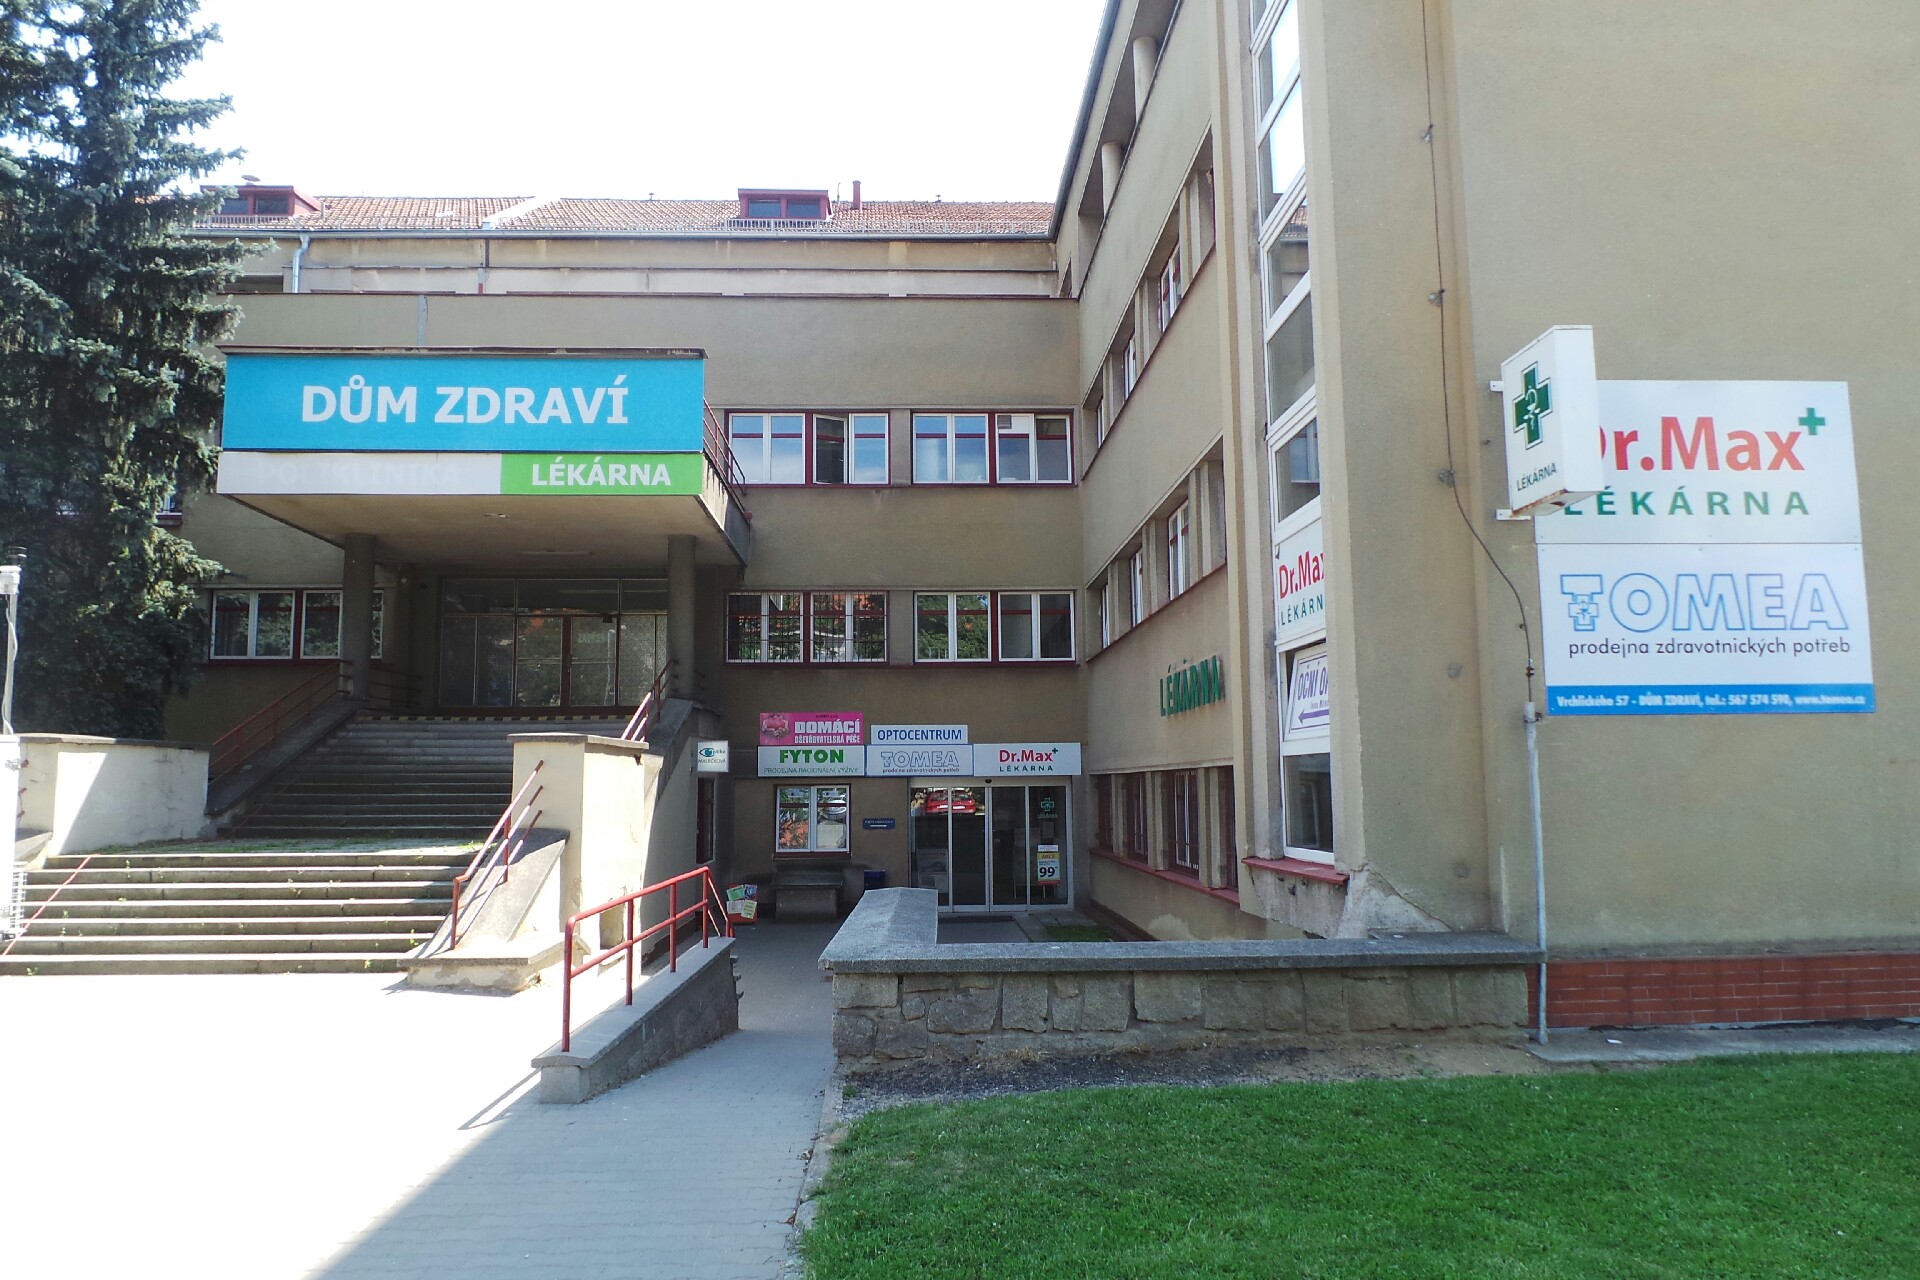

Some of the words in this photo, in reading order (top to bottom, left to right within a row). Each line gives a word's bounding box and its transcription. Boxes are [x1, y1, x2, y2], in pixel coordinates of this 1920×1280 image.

[302, 374, 418, 424] DŮM
[434, 374, 629, 425] ZDRAVÍ
[1599, 415, 1806, 472] r.Max
[531, 456, 672, 487] LÉKÁRNA
[1516, 462, 1558, 492] LÉKÁRNA
[1559, 572, 1849, 633] TOMEA
[1569, 637, 1650, 658] prodejna
[1656, 636, 1786, 658] zdravotnických
[1793, 636, 1851, 656] potřeb
[1159, 654, 1222, 717] LÉKÁRNA
[1297, 661, 1319, 701] OČNÍ
[794, 718, 860, 734] DOMÁCÍ
[877, 729, 963, 741] OPTOCENTRUM
[779, 749, 844, 764] FYTON
[880, 750, 960, 768] TOMEA
[999, 764, 1054, 773] LÉKÁRNA
[1039, 866, 1056, 878] 99
